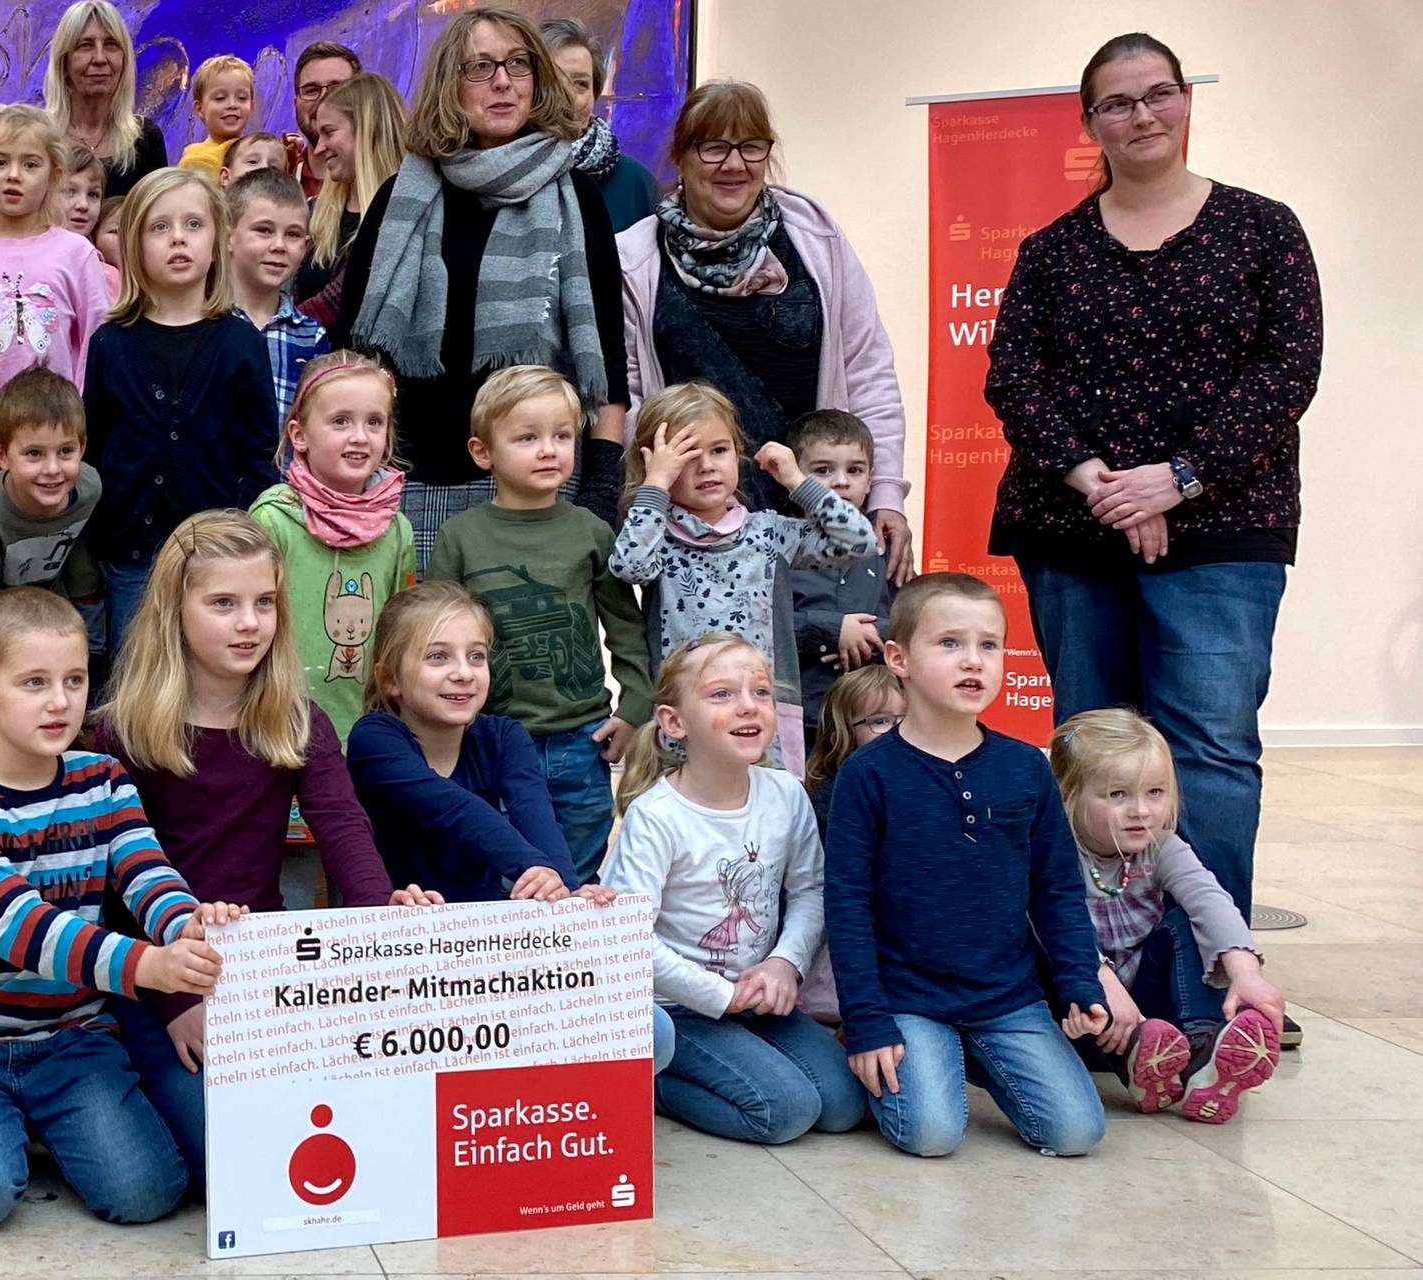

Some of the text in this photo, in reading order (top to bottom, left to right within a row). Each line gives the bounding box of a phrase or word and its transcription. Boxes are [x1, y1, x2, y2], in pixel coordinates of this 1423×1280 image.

[933, 114, 1000, 130] Sparkasse
[933, 127, 1038, 145] HagenHerdecke
[257, 921, 303, 937] einfach
[330, 940, 424, 964] Sparkasse
[430, 931, 572, 958] HagenHerdecke
[623, 947, 654, 963] einfa
[275, 980, 400, 1008] Kalender-
[409, 966, 595, 999] Mitmachaktion
[629, 1023, 654, 1039] einf
[353, 1032, 373, 1059] €
[382, 1023, 510, 1057] 6.000,00
[452, 1098, 598, 1135] Sparkasse.
[454, 1131, 614, 1167] Einfach Gut.
[519, 1200, 605, 1216] Wenn's um Geld geht
